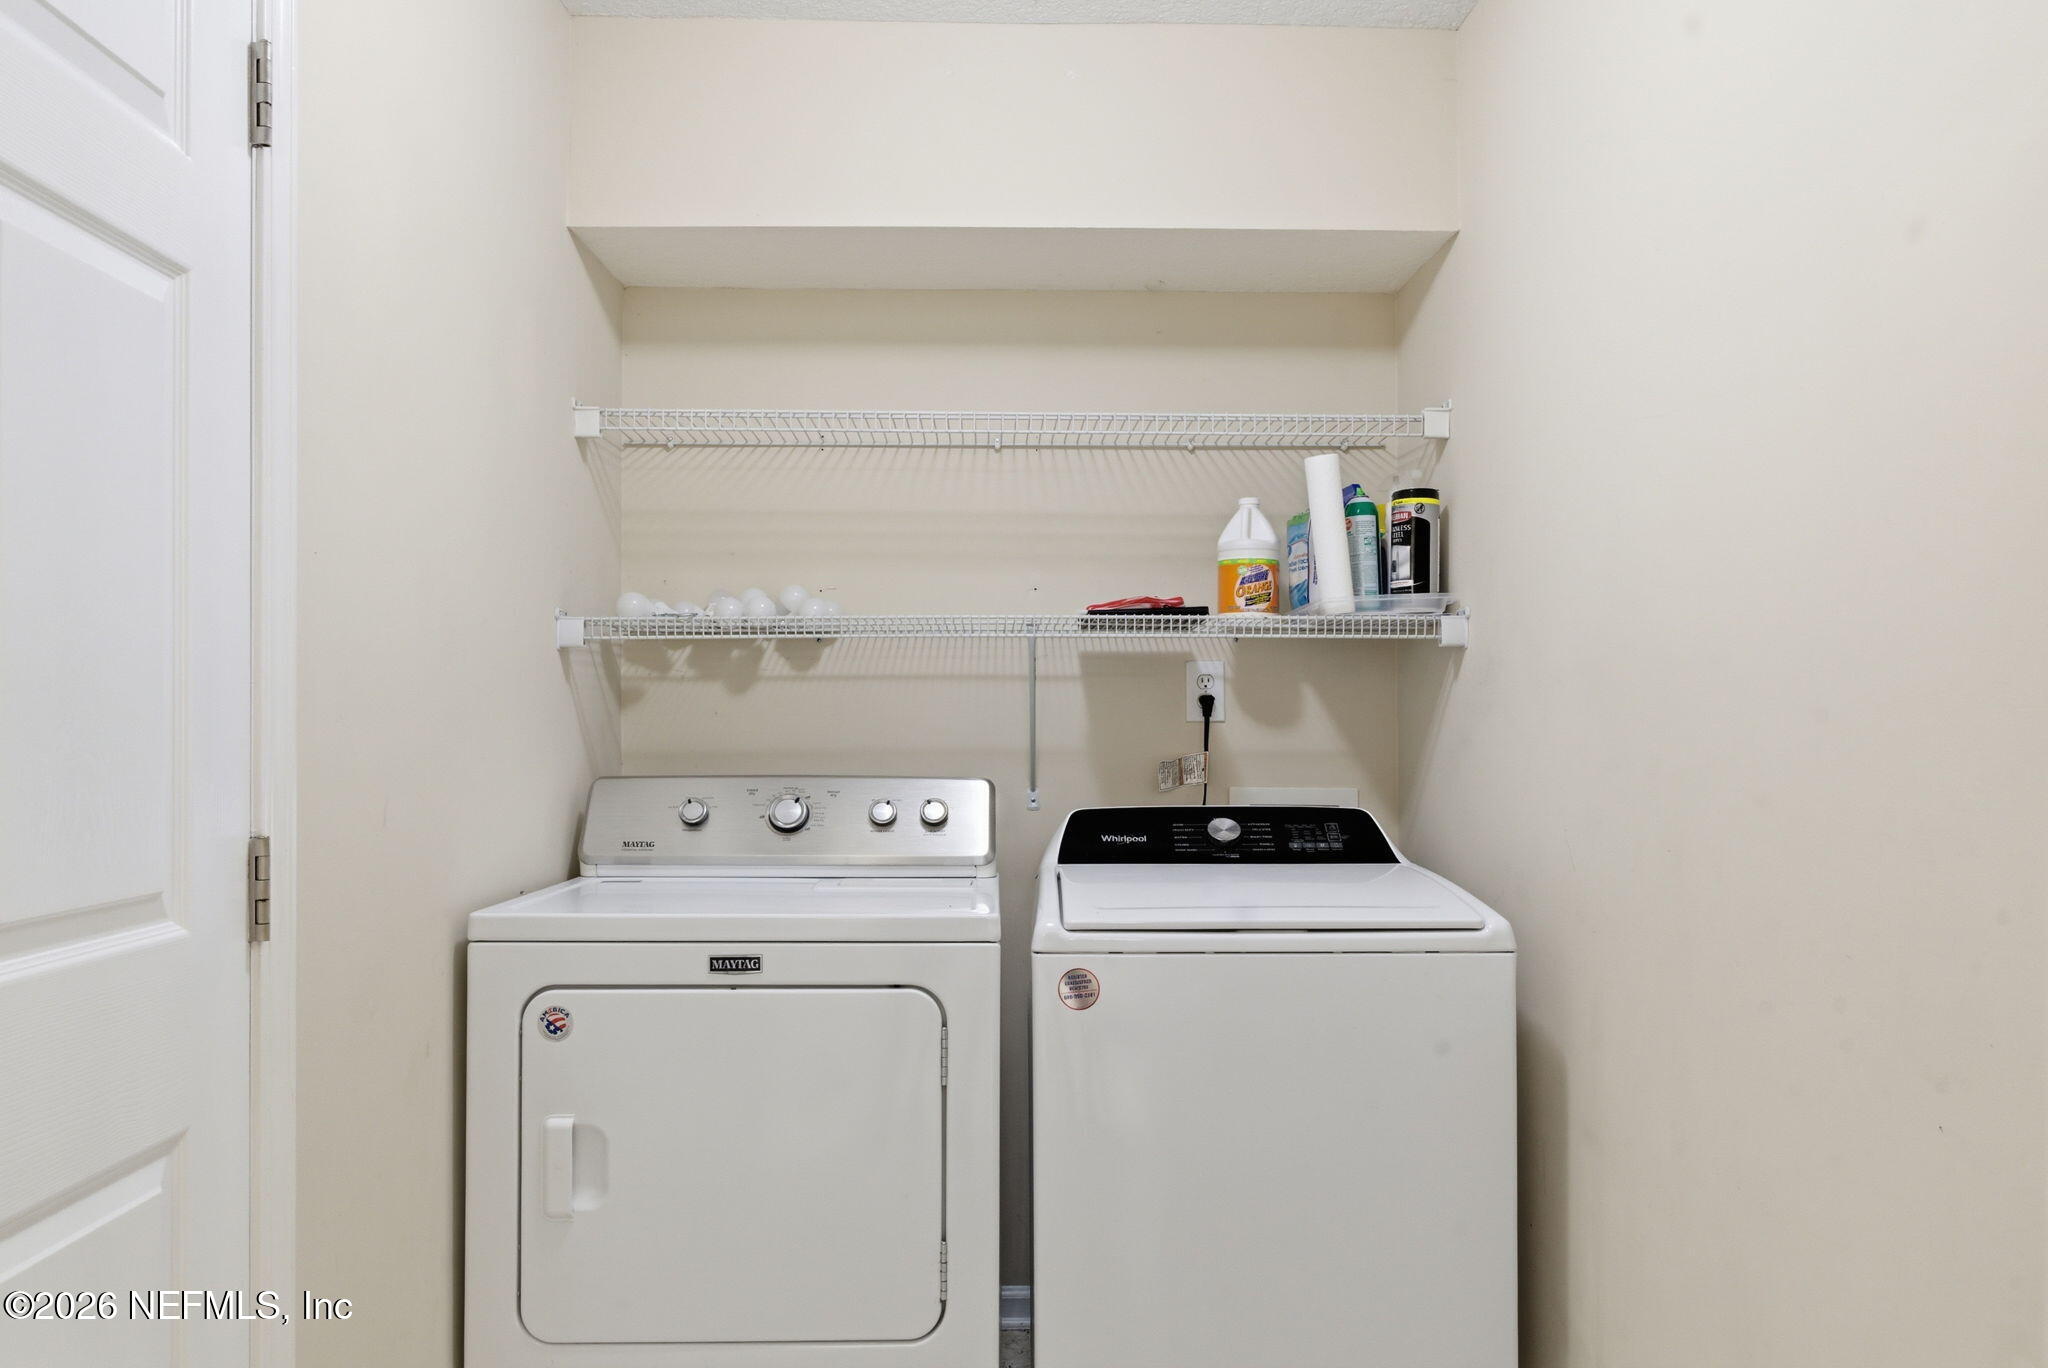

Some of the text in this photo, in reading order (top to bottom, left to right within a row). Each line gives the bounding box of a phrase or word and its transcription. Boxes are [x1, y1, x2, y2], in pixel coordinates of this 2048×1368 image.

[1235, 580, 1273, 598] ORANGE
[1101, 834, 1147, 844] Whirlpool
[711, 959, 760, 969] MAYTAG
[540, 1007, 570, 1022] AMERICA
